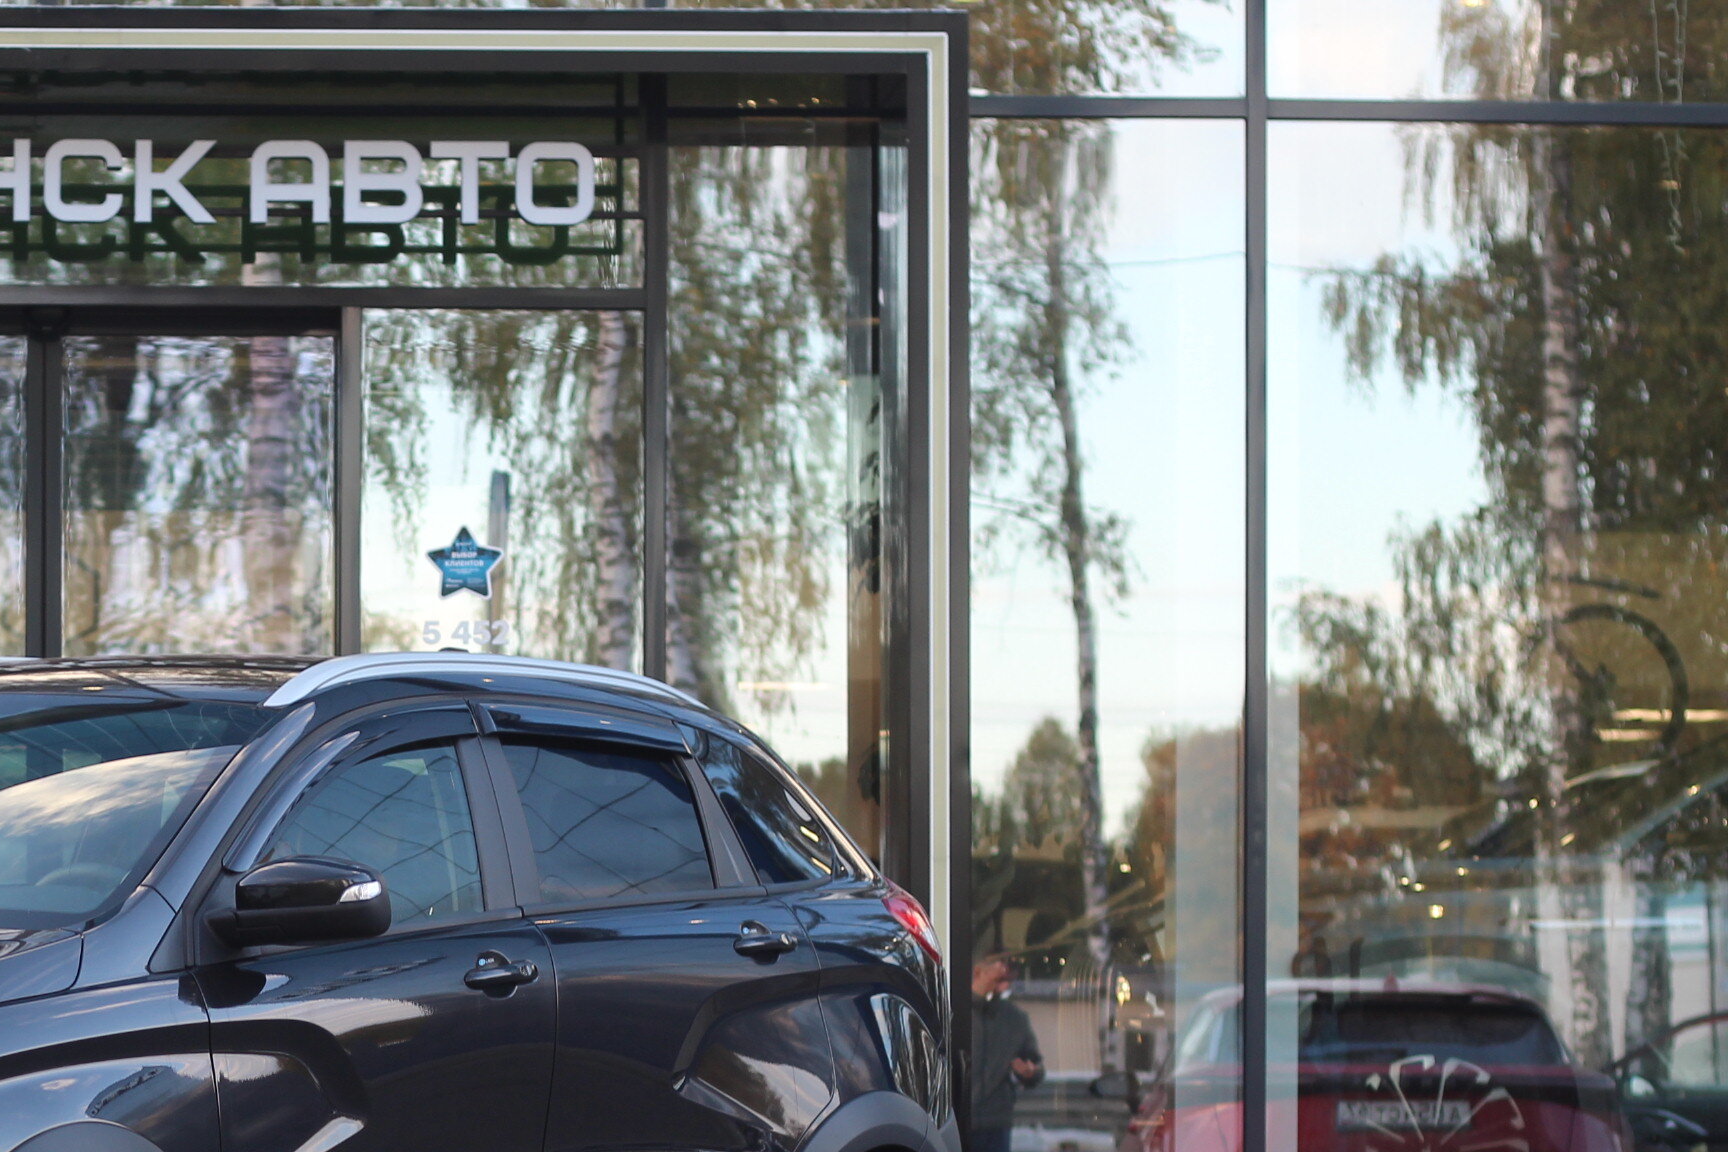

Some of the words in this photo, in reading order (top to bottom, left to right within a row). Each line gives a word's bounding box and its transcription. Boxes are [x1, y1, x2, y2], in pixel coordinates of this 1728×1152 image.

[249, 139, 595, 226] АВТО
[423, 620, 441, 645] 5
[451, 620, 510, 645] 452
